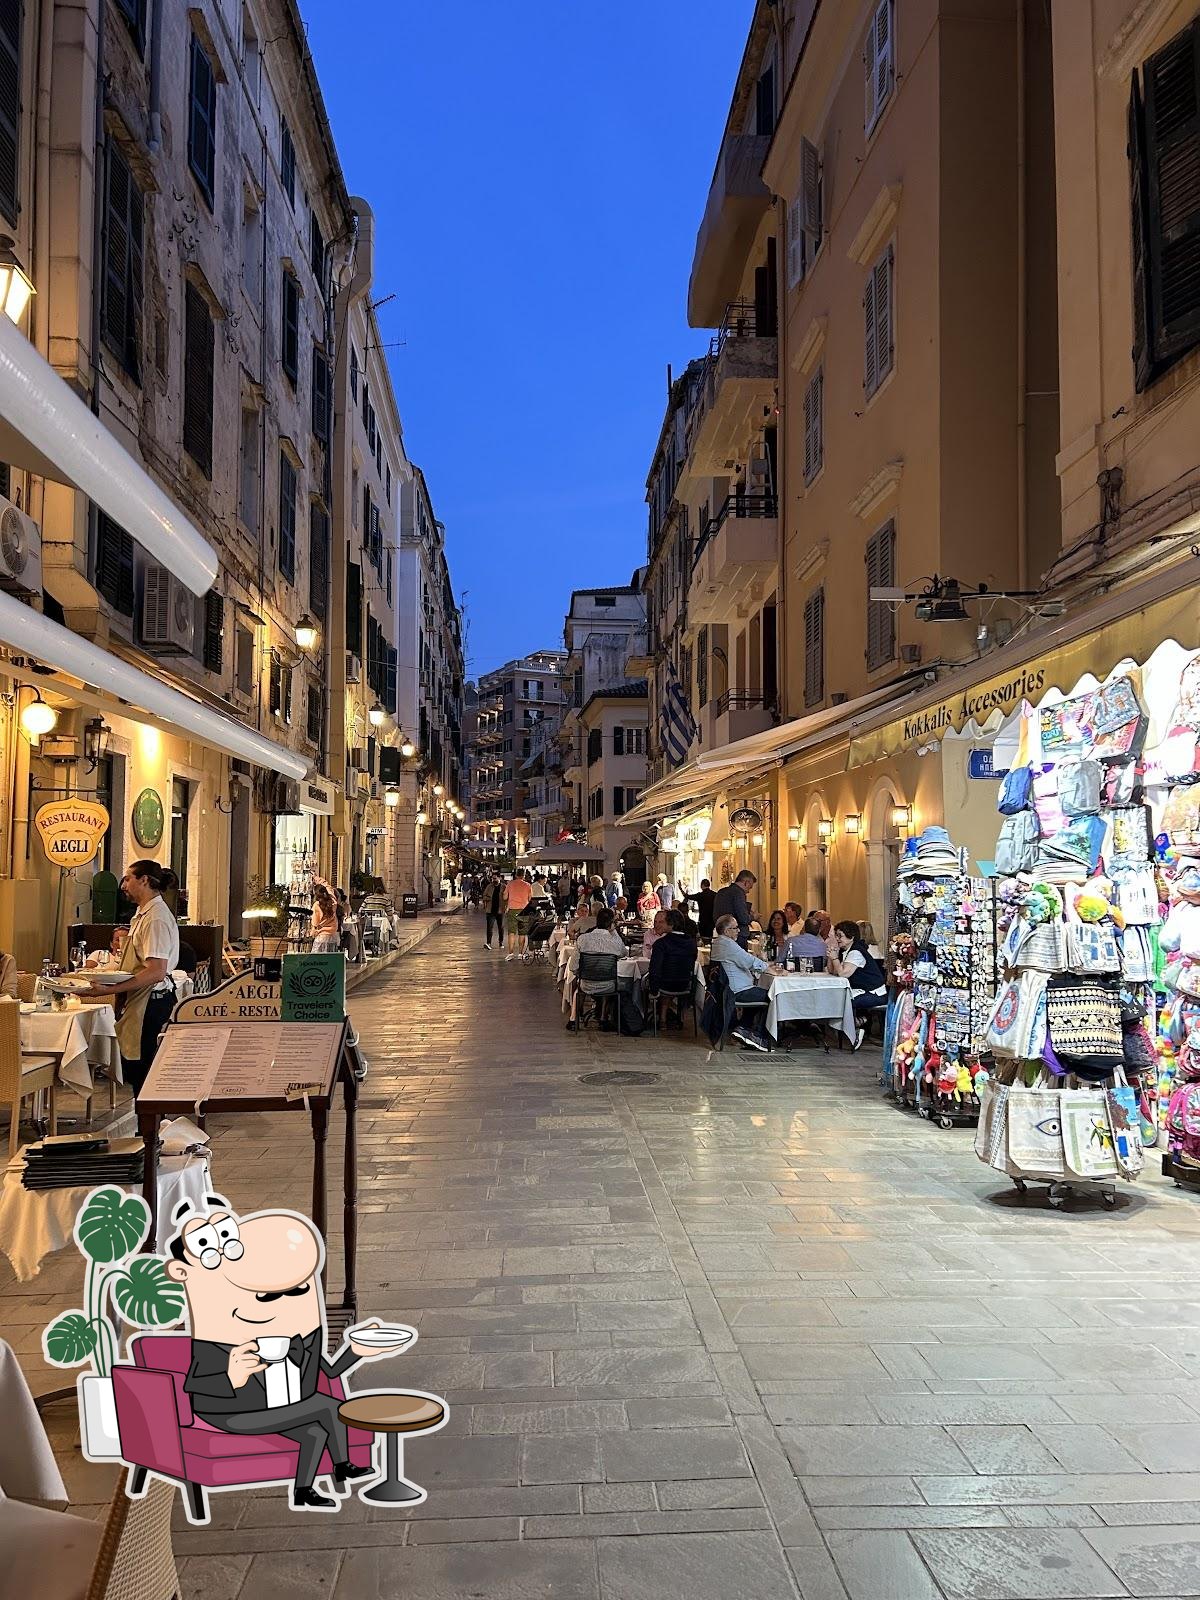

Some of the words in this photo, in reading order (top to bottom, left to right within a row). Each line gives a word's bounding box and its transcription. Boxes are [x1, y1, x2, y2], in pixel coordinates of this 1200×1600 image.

[903, 705, 953, 741] Kokkalis
[958, 669, 1045, 720] Accessories
[40, 812, 105, 830] RESTAURANT
[51, 839, 89, 853] AEGLI
[194, 1002, 228, 1017] CAFÉ
[238, 1005, 279, 1017] RESTA
[294, 1010, 330, 1020] Choice
